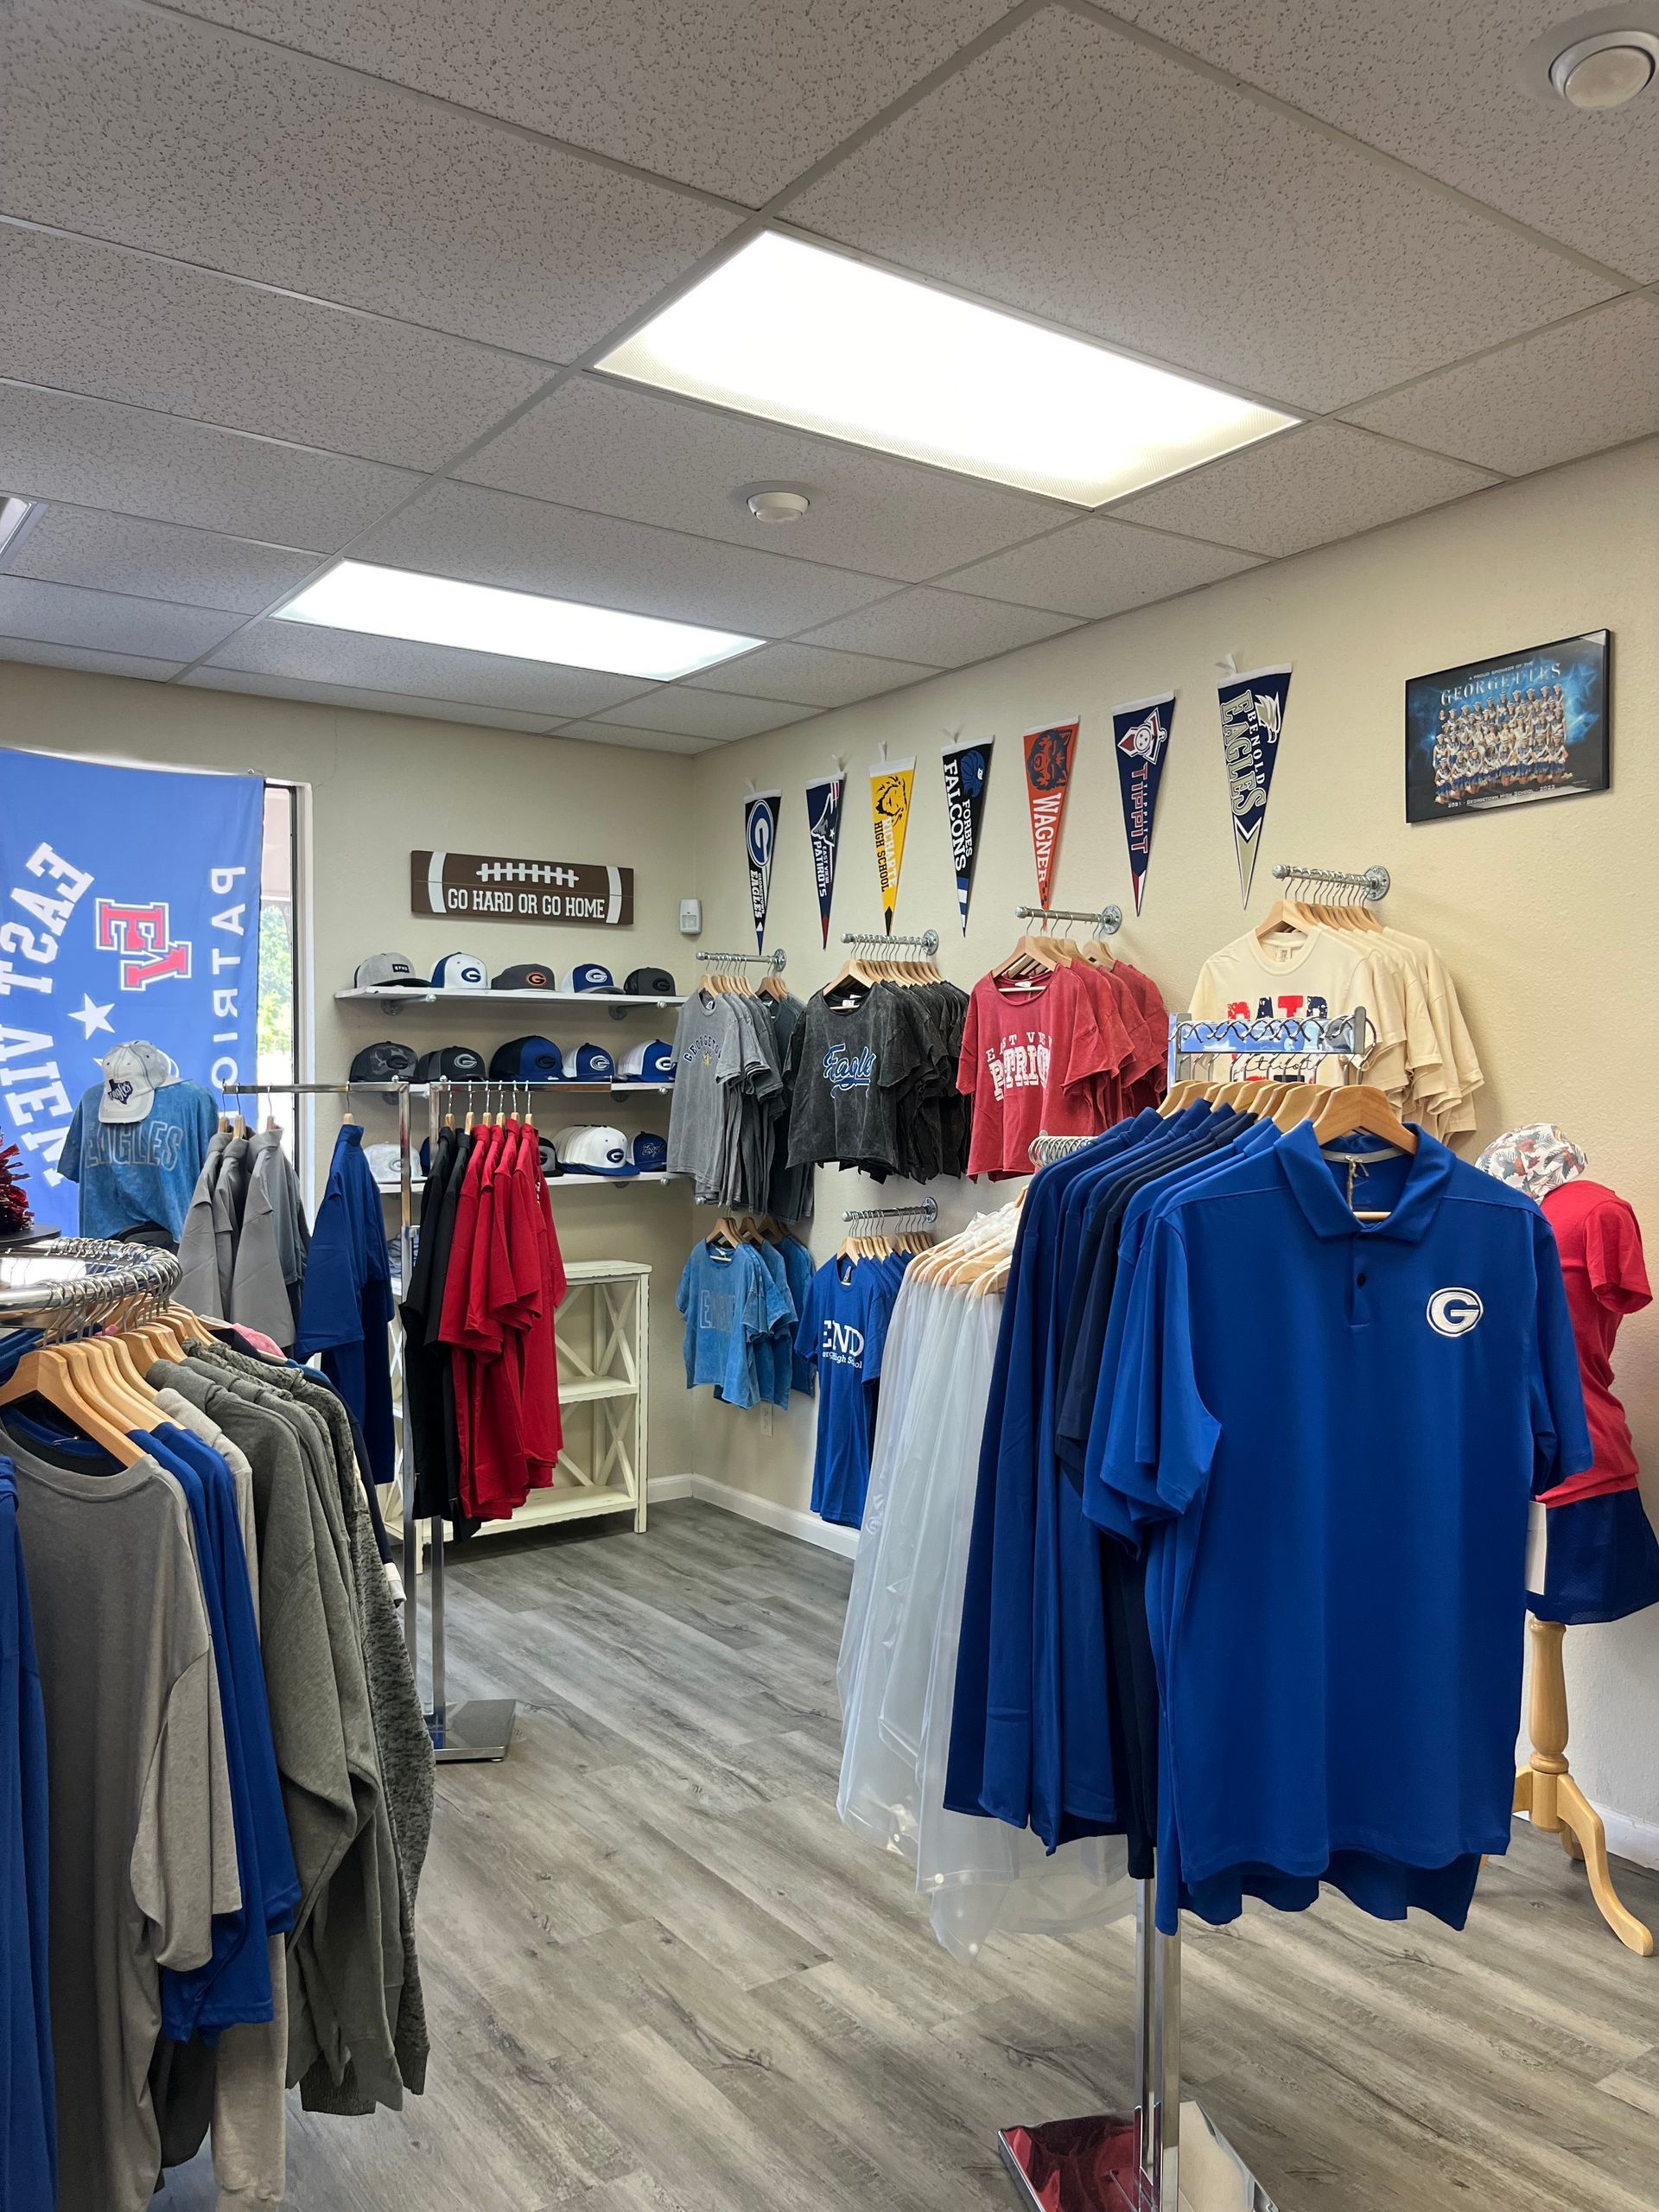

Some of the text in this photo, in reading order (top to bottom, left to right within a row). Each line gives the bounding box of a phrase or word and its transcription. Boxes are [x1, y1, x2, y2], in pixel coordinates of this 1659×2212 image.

[1440, 663, 1562, 706] GEORGETTES
[1491, 665, 1514, 675] SPONSOR
[1221, 690, 1267, 816] EAGLES
[1248, 710, 1266, 785] BENOLD
[944, 760, 966, 871] FALCONS
[963, 799, 972, 857] FORBES
[1033, 792, 1062, 882] WAGNER
[1131, 761, 1148, 854] TIPPIT
[874, 821, 889, 892] HIGH SCHOOL
[883, 817, 897, 886] RICHARTE
[448, 888, 605, 918] GO HARD OR GO HOME
[750, 869, 762, 918] EAGLES
[1427, 1287, 1484, 1338] G
